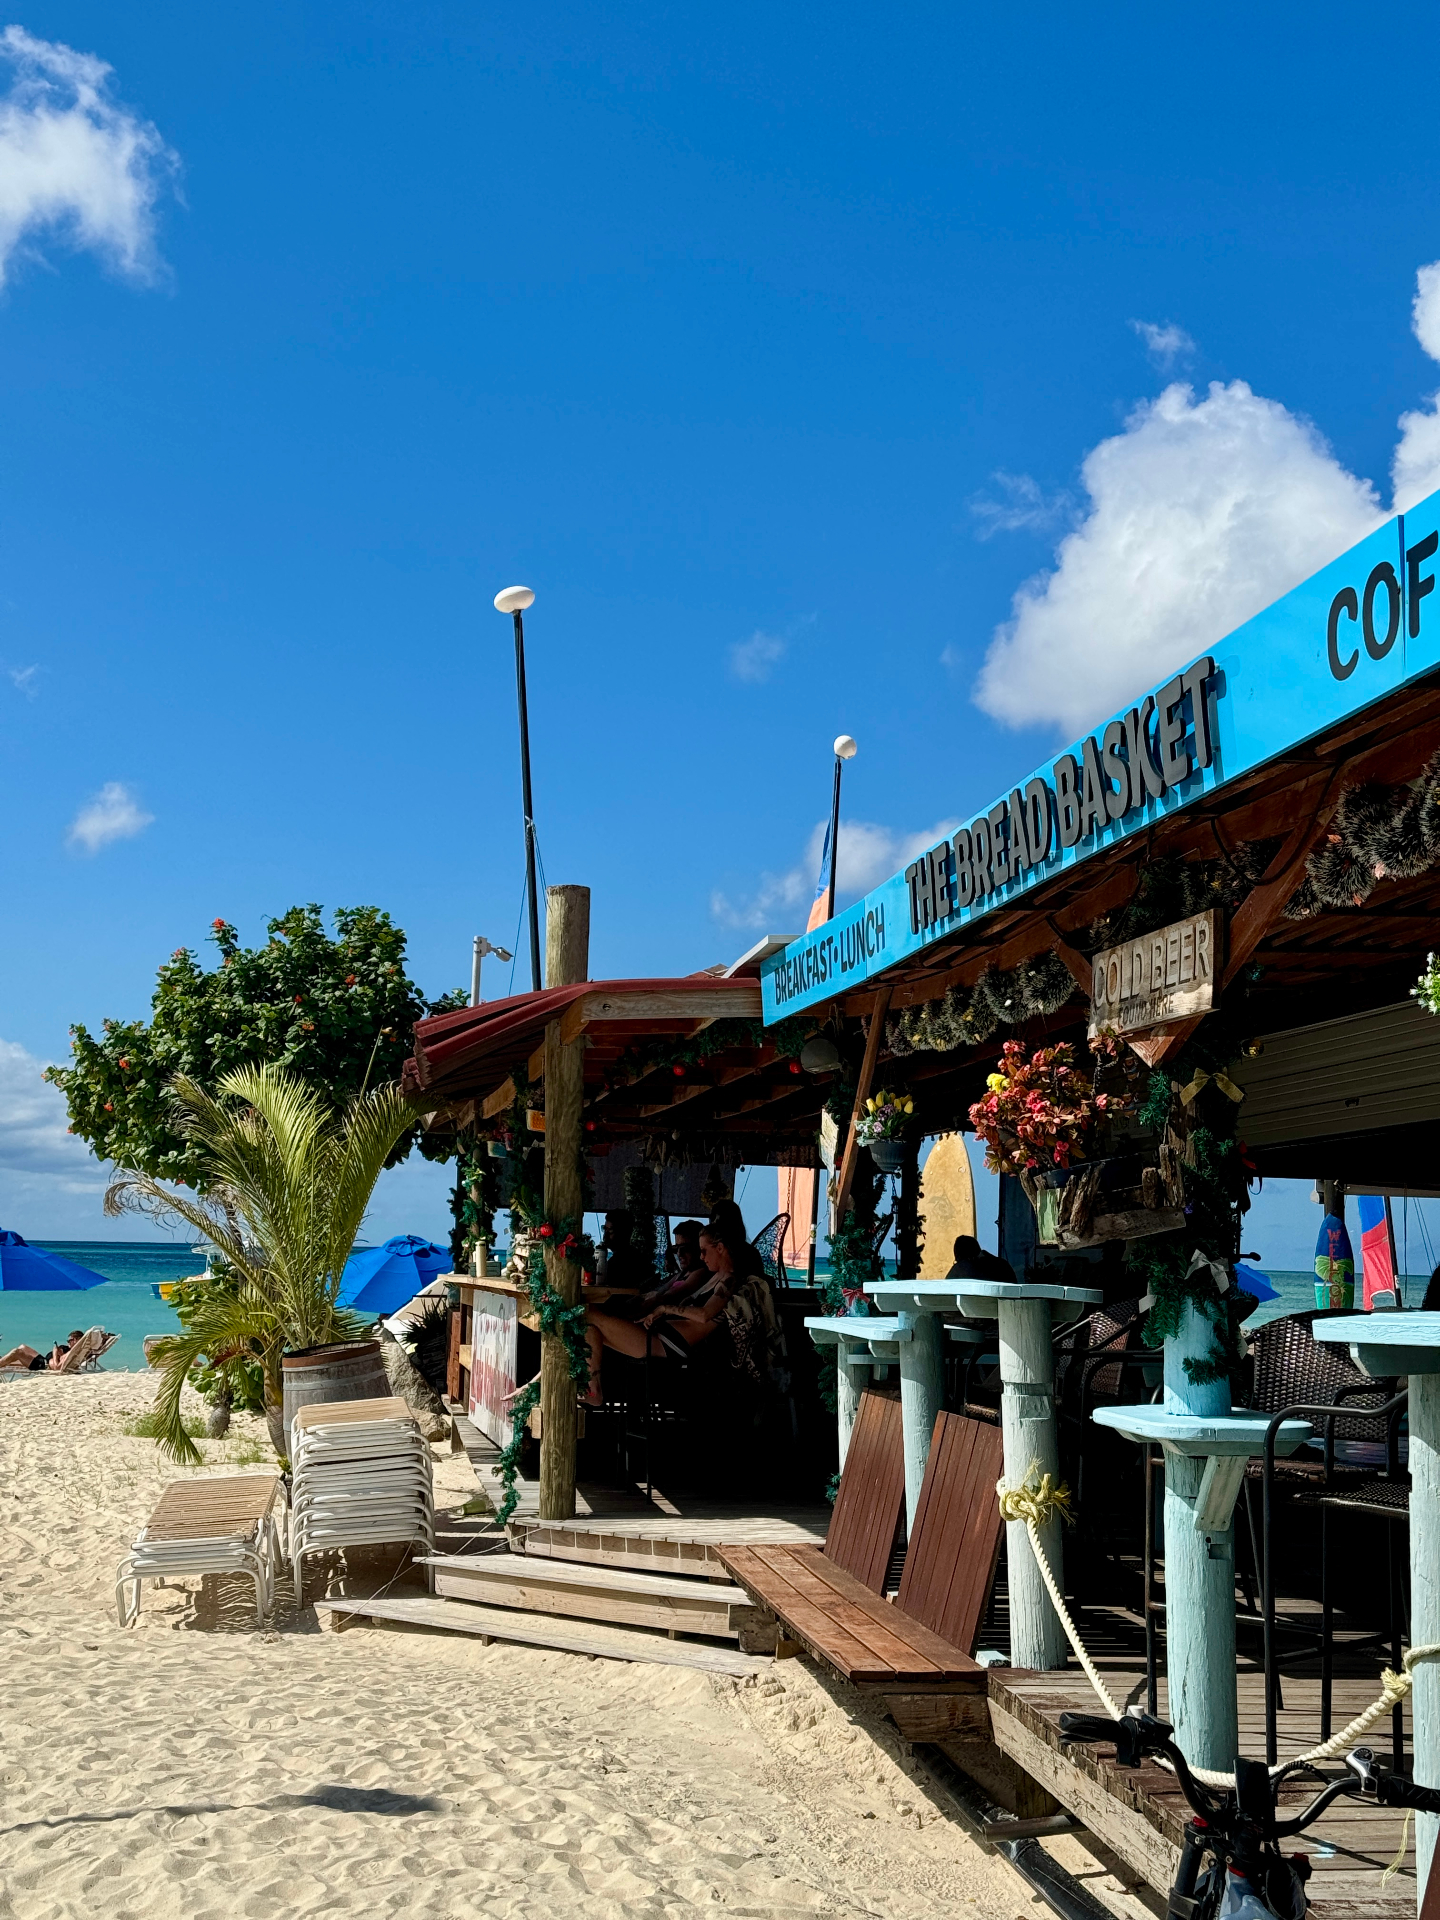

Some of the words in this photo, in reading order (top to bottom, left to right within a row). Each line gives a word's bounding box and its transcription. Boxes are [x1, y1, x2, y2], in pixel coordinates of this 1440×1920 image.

[1327, 529, 1438, 681] COF
[905, 841, 950, 934] THE
[953, 778, 1051, 907] BREAD
[1053, 656, 1216, 847] BASKET
[774, 935, 833, 1006] BREAKFAST
[840, 902, 885, 973] LUNCH
[1094, 946, 1144, 1008] COLD
[1151, 920, 1210, 993] BEER
[1149, 993, 1174, 1018] HERE
[1327, 1228, 1342, 1309] WELCOM
